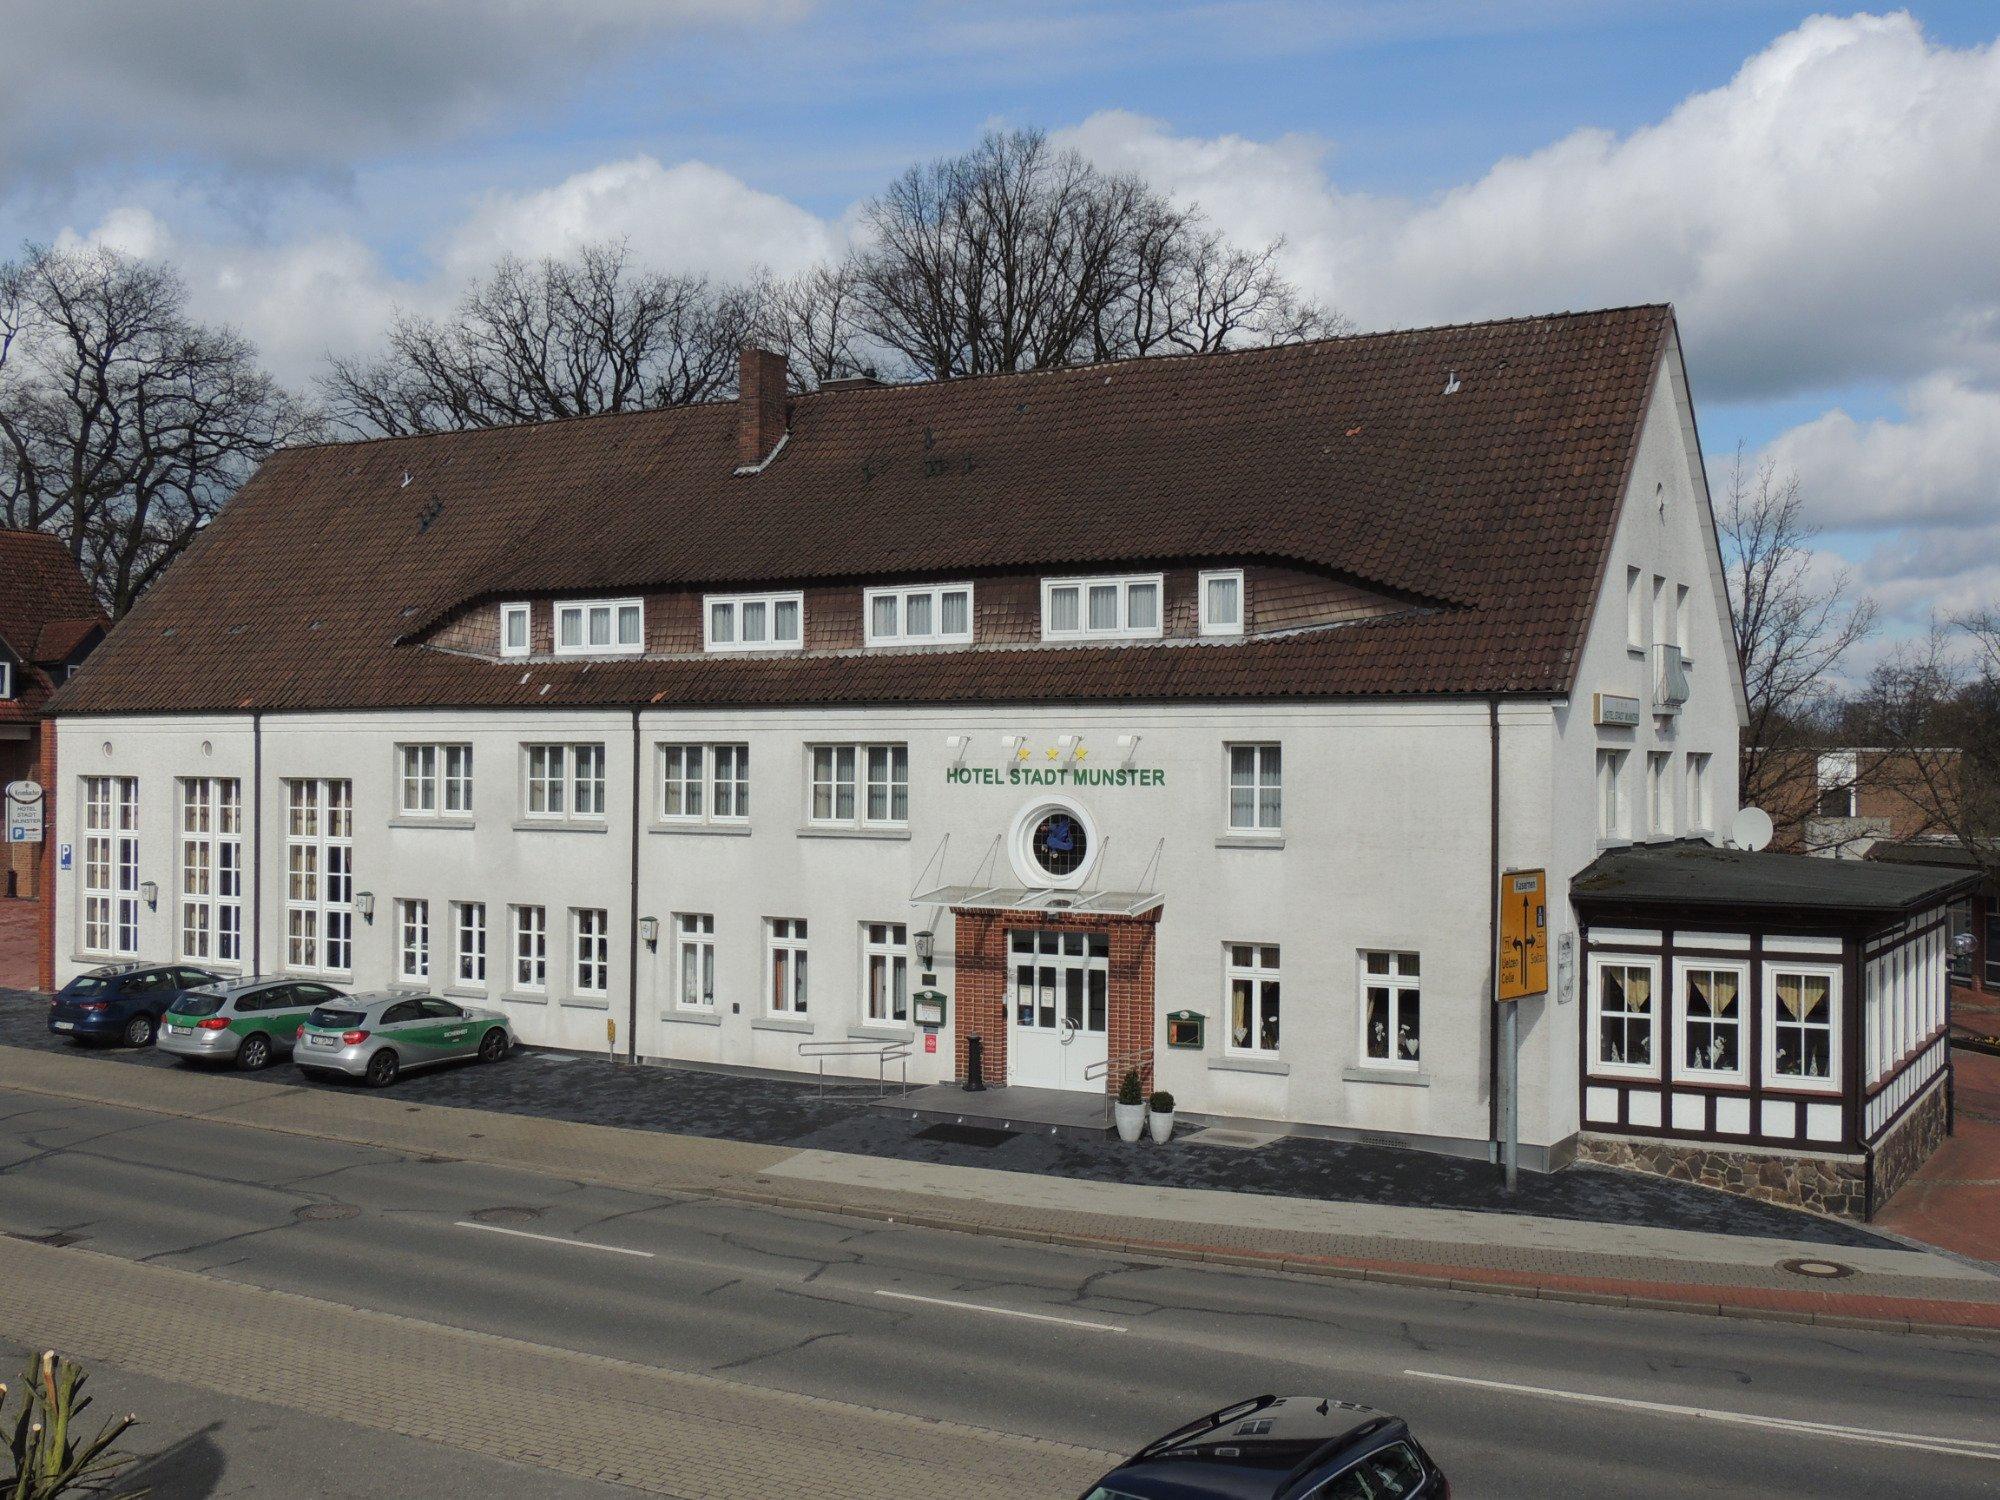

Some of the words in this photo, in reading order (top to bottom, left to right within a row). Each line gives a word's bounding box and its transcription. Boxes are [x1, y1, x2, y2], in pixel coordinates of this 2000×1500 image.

[946, 768, 1004, 785] HOTEL
[1010, 768, 1068, 786] STADT
[1073, 769, 1165, 786] MUNSTER
